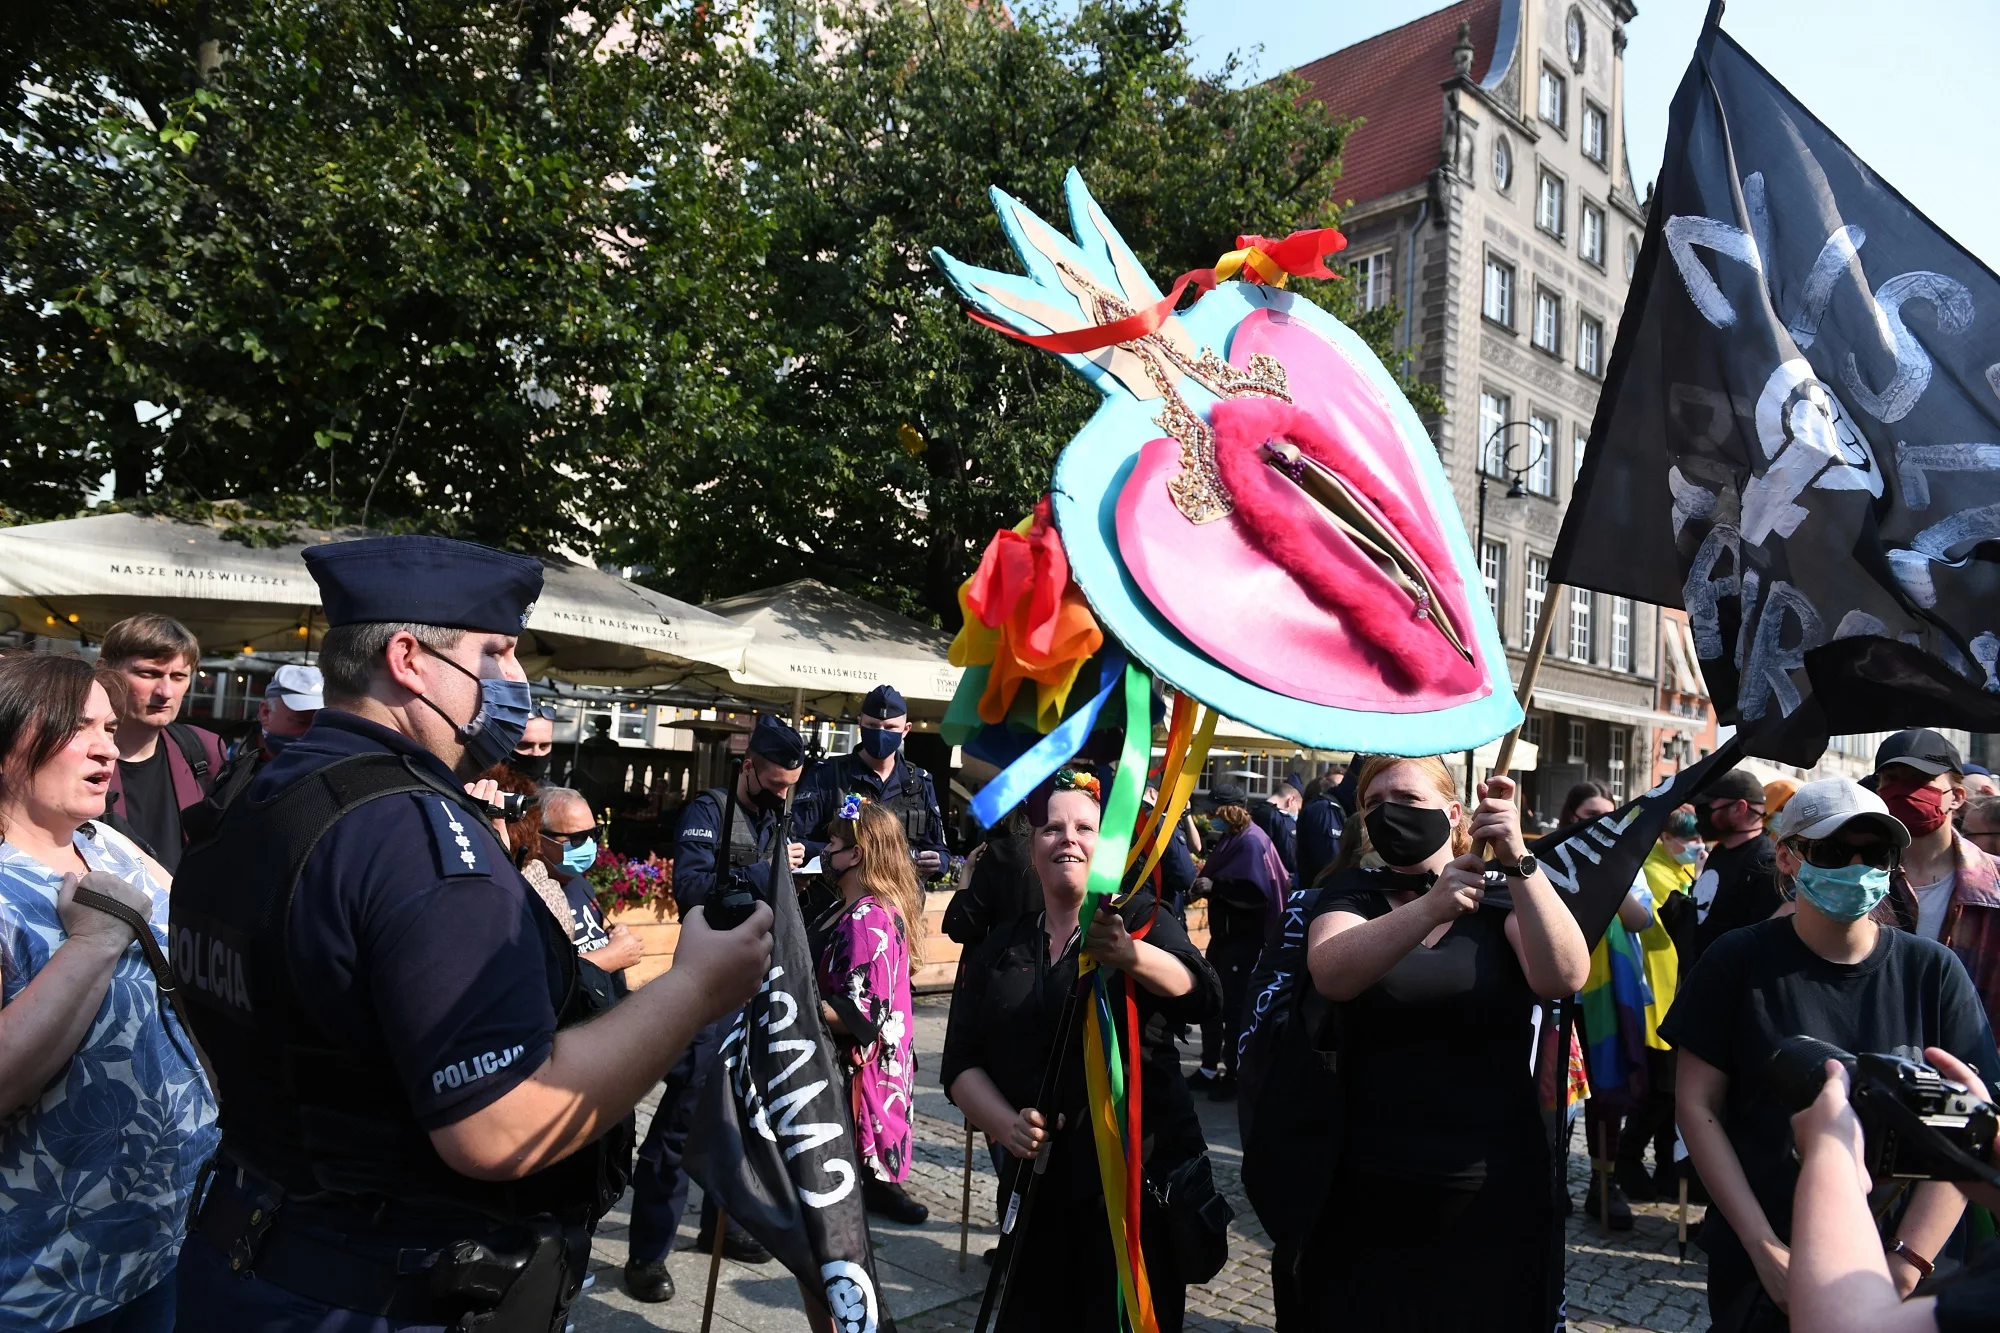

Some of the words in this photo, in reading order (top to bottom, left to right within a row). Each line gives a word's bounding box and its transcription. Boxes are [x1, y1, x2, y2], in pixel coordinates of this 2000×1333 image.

[110, 564, 166, 577] NASZE
[553, 611, 594, 625] NASZE
[790, 664, 818, 675] NASZE
[682, 829, 713, 839] POLICJA
[169, 922, 252, 1012] POLICJA
[431, 1044, 525, 1095] POLICJA
